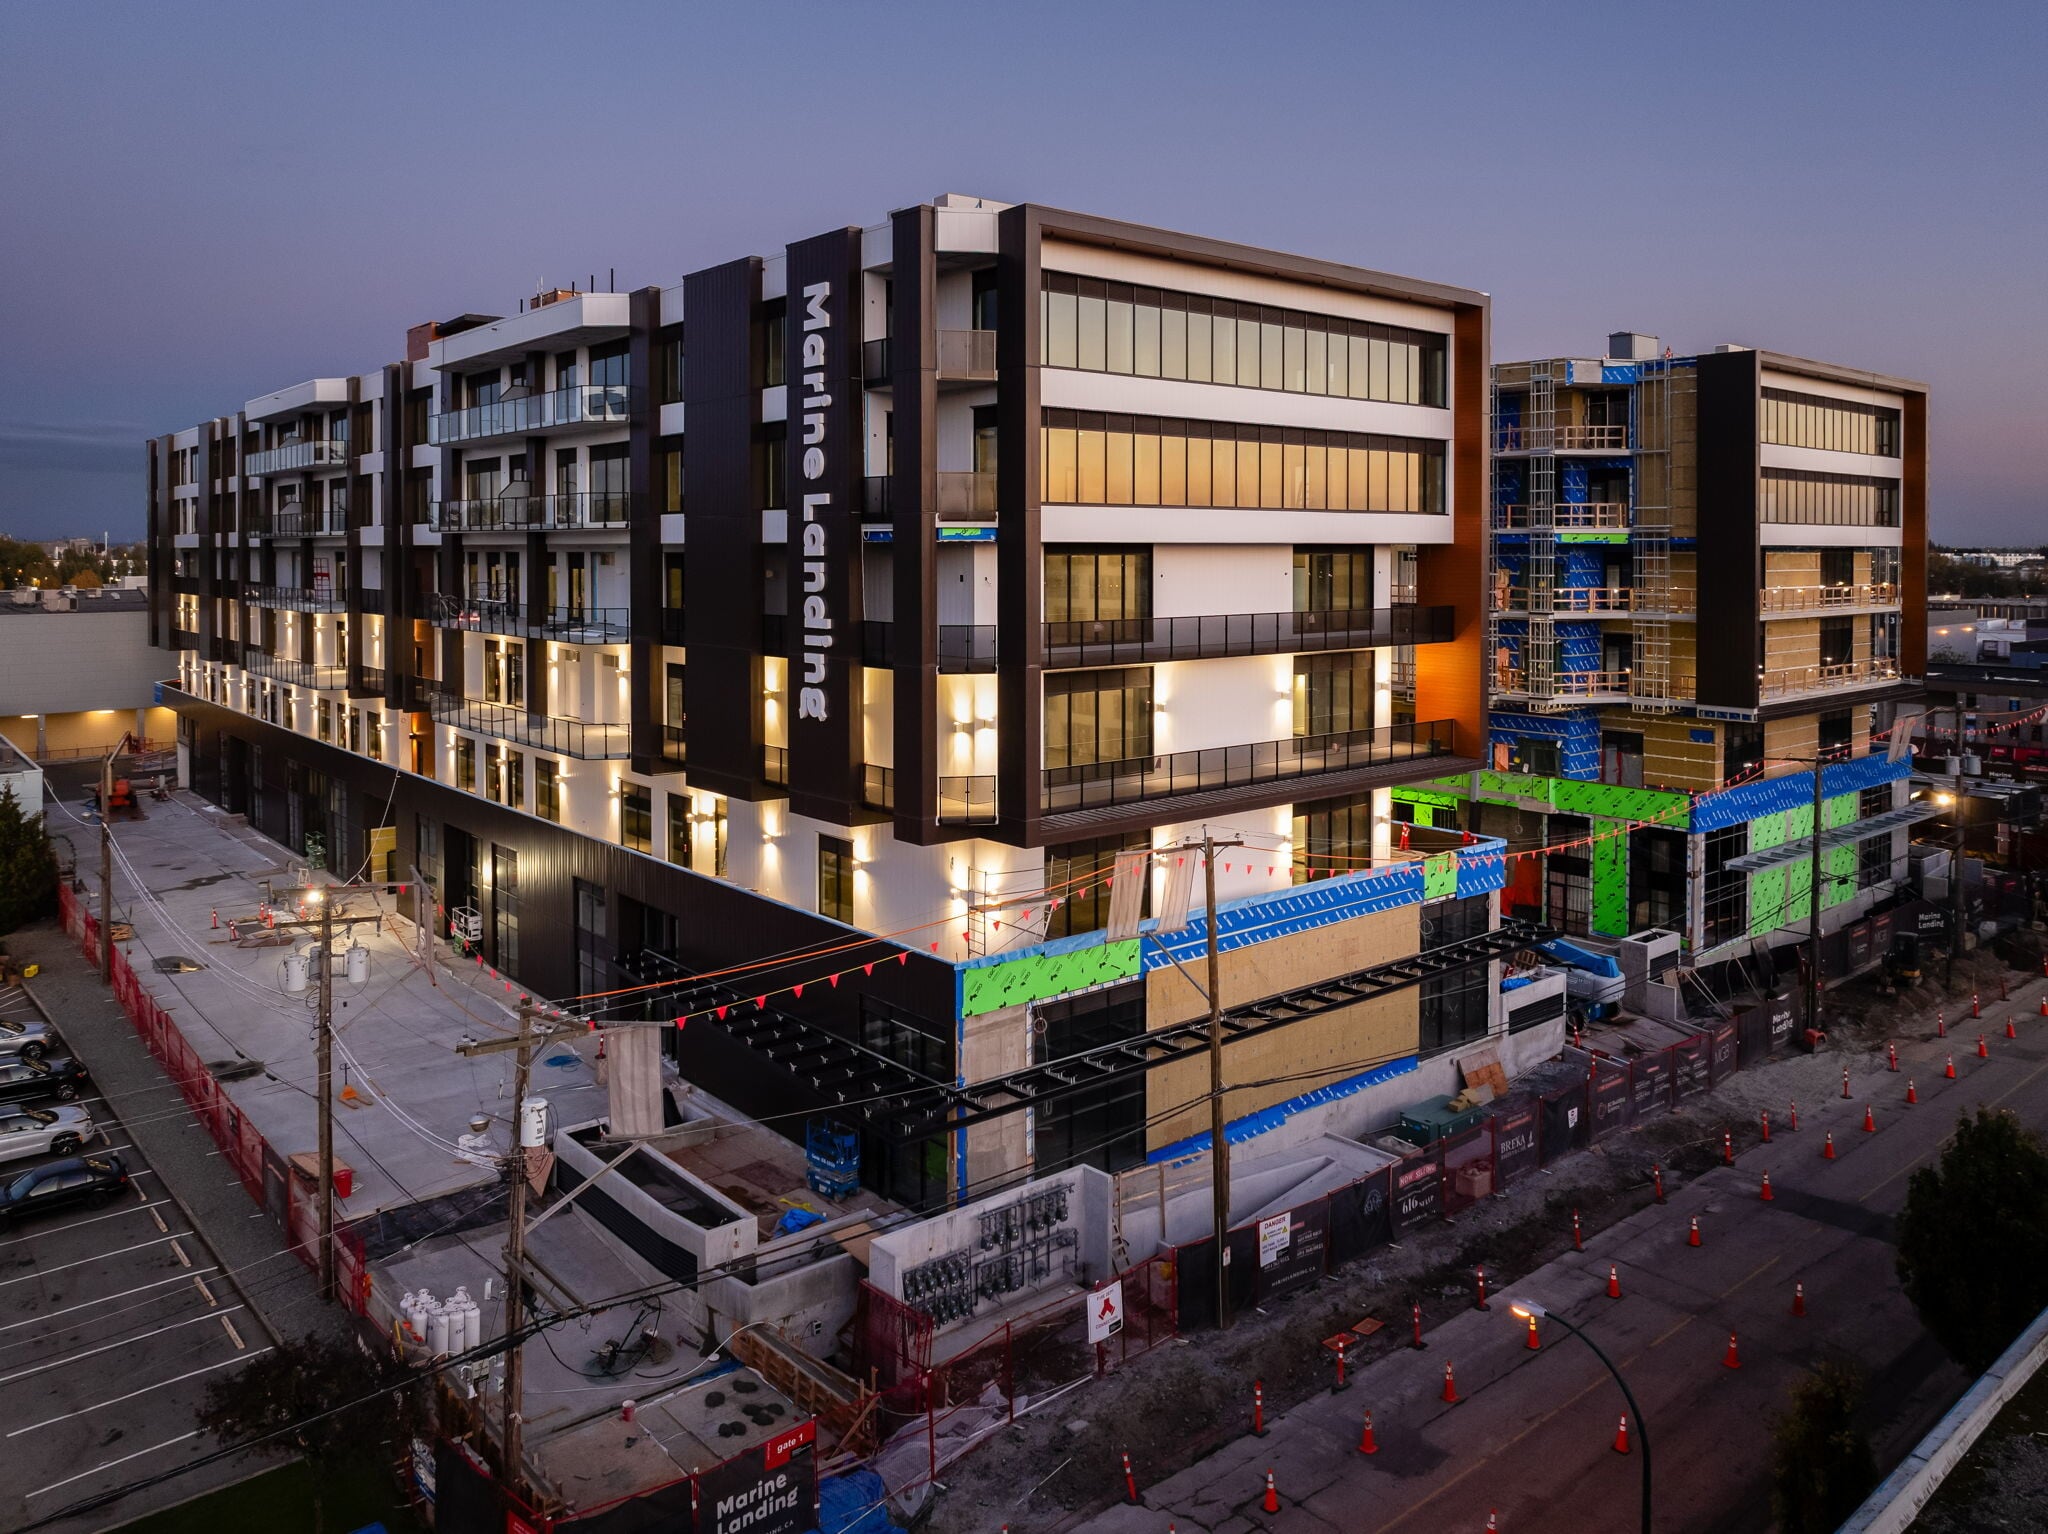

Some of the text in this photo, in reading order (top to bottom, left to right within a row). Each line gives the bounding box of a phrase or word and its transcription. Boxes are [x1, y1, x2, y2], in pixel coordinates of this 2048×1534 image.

[799, 281, 833, 722] Marine Landing
[1918, 912, 1941, 922] Marine
[1918, 918, 1944, 929] Landing
[1500, 1134, 1526, 1154] BREKA
[1400, 1174, 1413, 1186] NOW
[1264, 1216, 1286, 1229] DANGER
[777, 1437, 796, 1454] gate
[798, 1433, 803, 1442] 1
[717, 1474, 787, 1520] Marine
[717, 1486, 798, 1534] Landing
